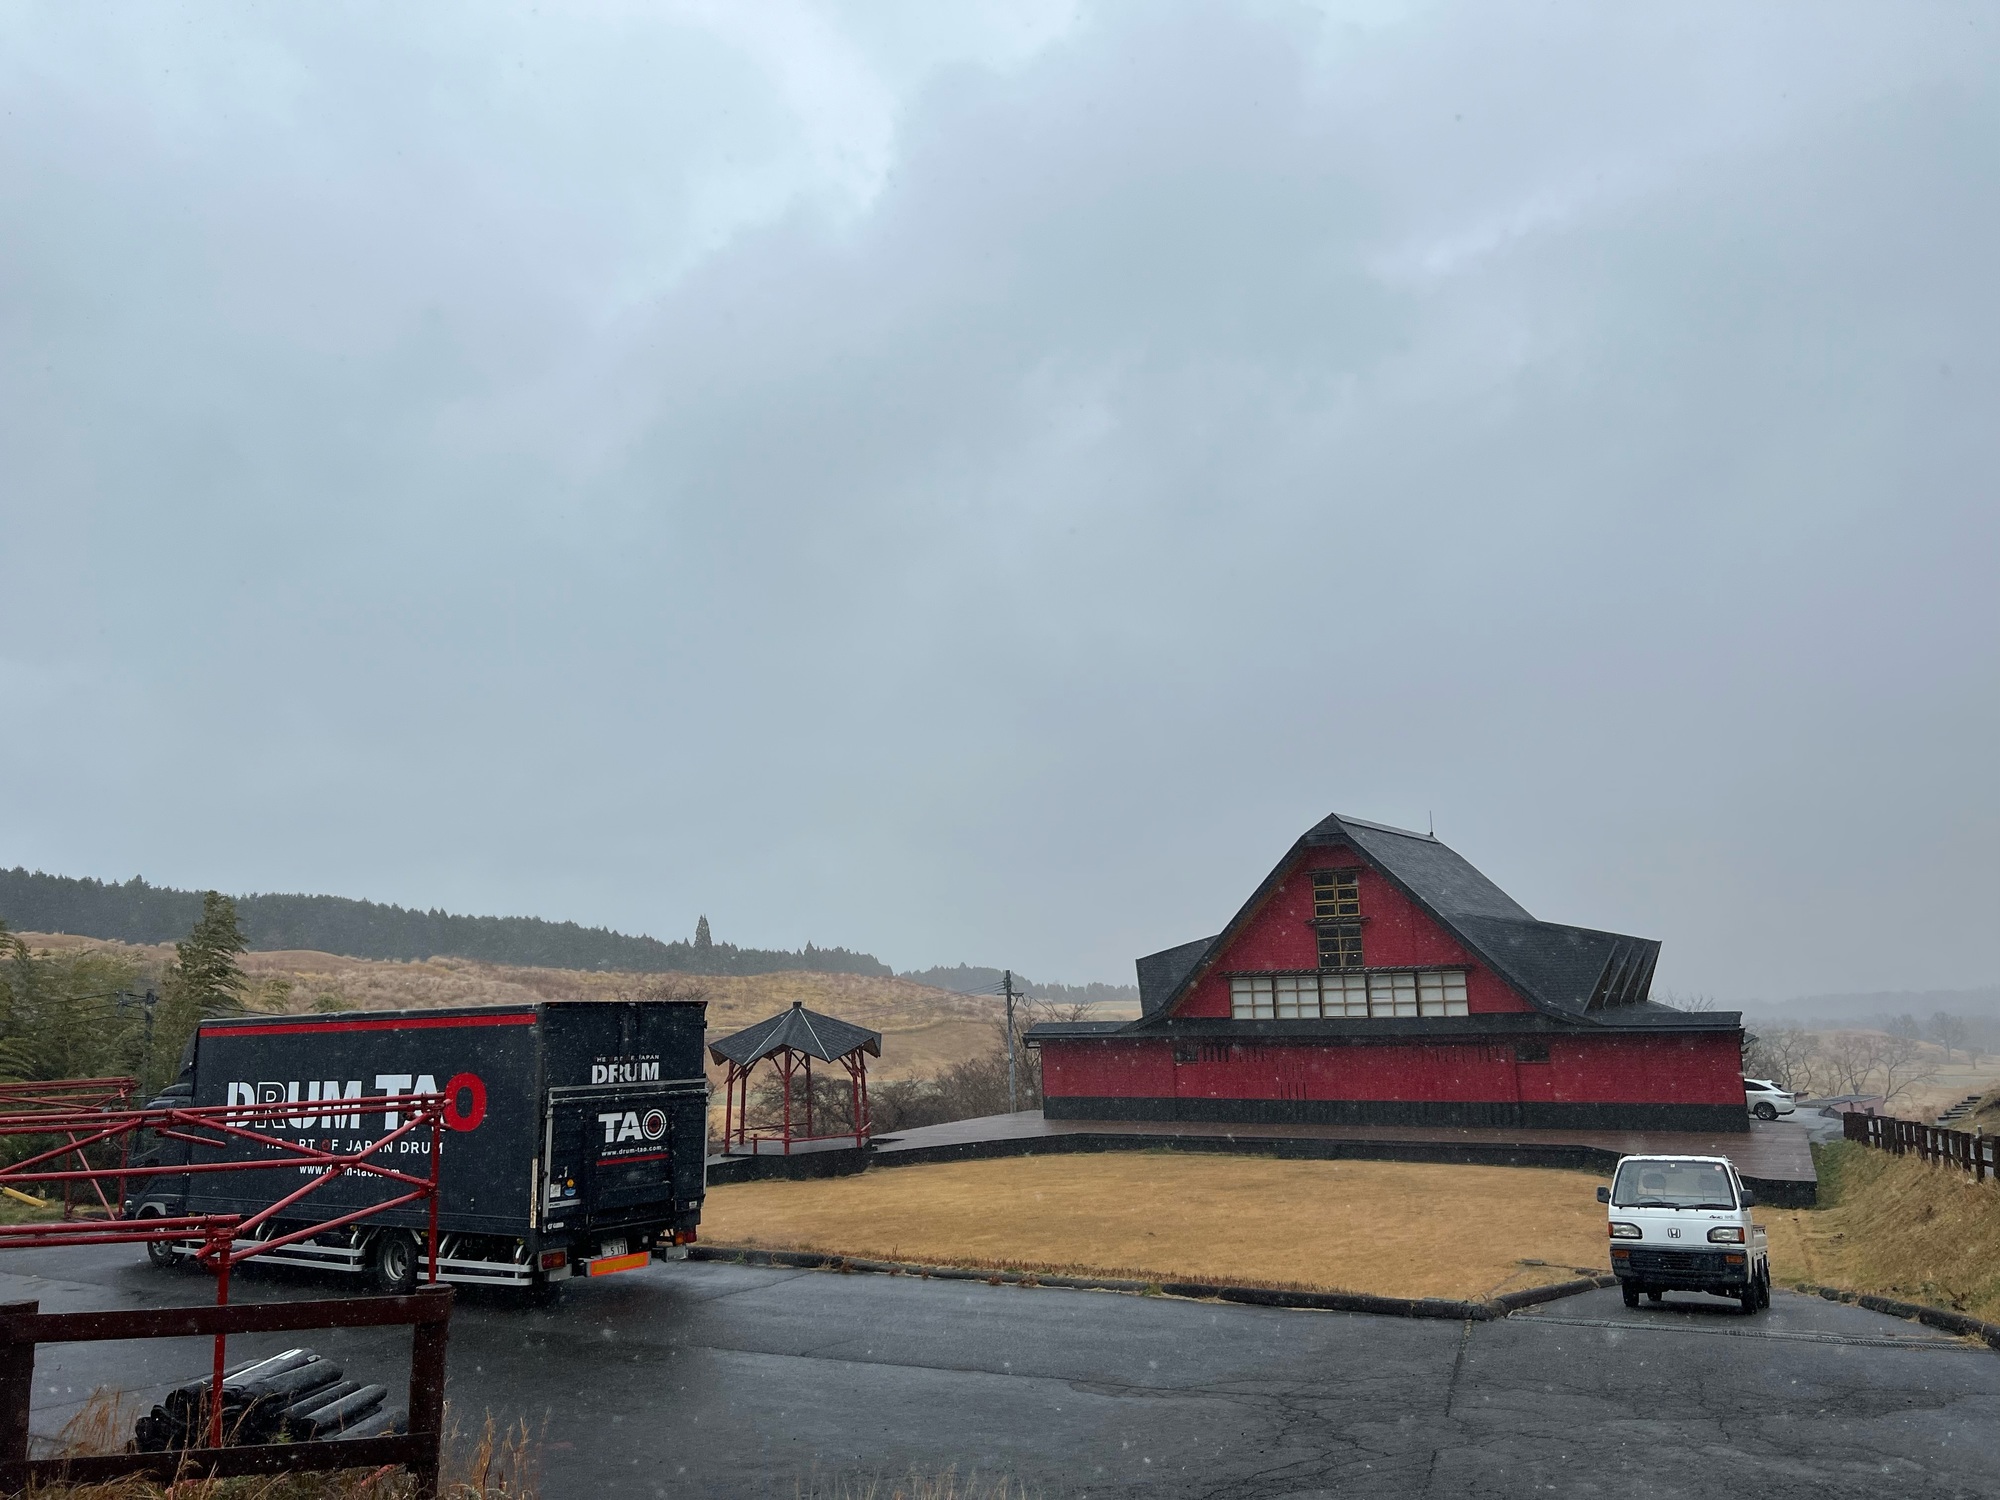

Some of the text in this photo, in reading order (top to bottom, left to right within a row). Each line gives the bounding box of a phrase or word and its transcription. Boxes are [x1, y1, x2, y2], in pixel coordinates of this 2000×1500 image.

[591, 1062, 660, 1084] DRUM
[226, 1072, 487, 1132] DRUM TAO
[598, 1108, 667, 1143] TAO
[289, 1138, 316, 1151] RT
[345, 1139, 393, 1153] JAPN
[601, 1145, 662, 1156] www.drum-tao.com
